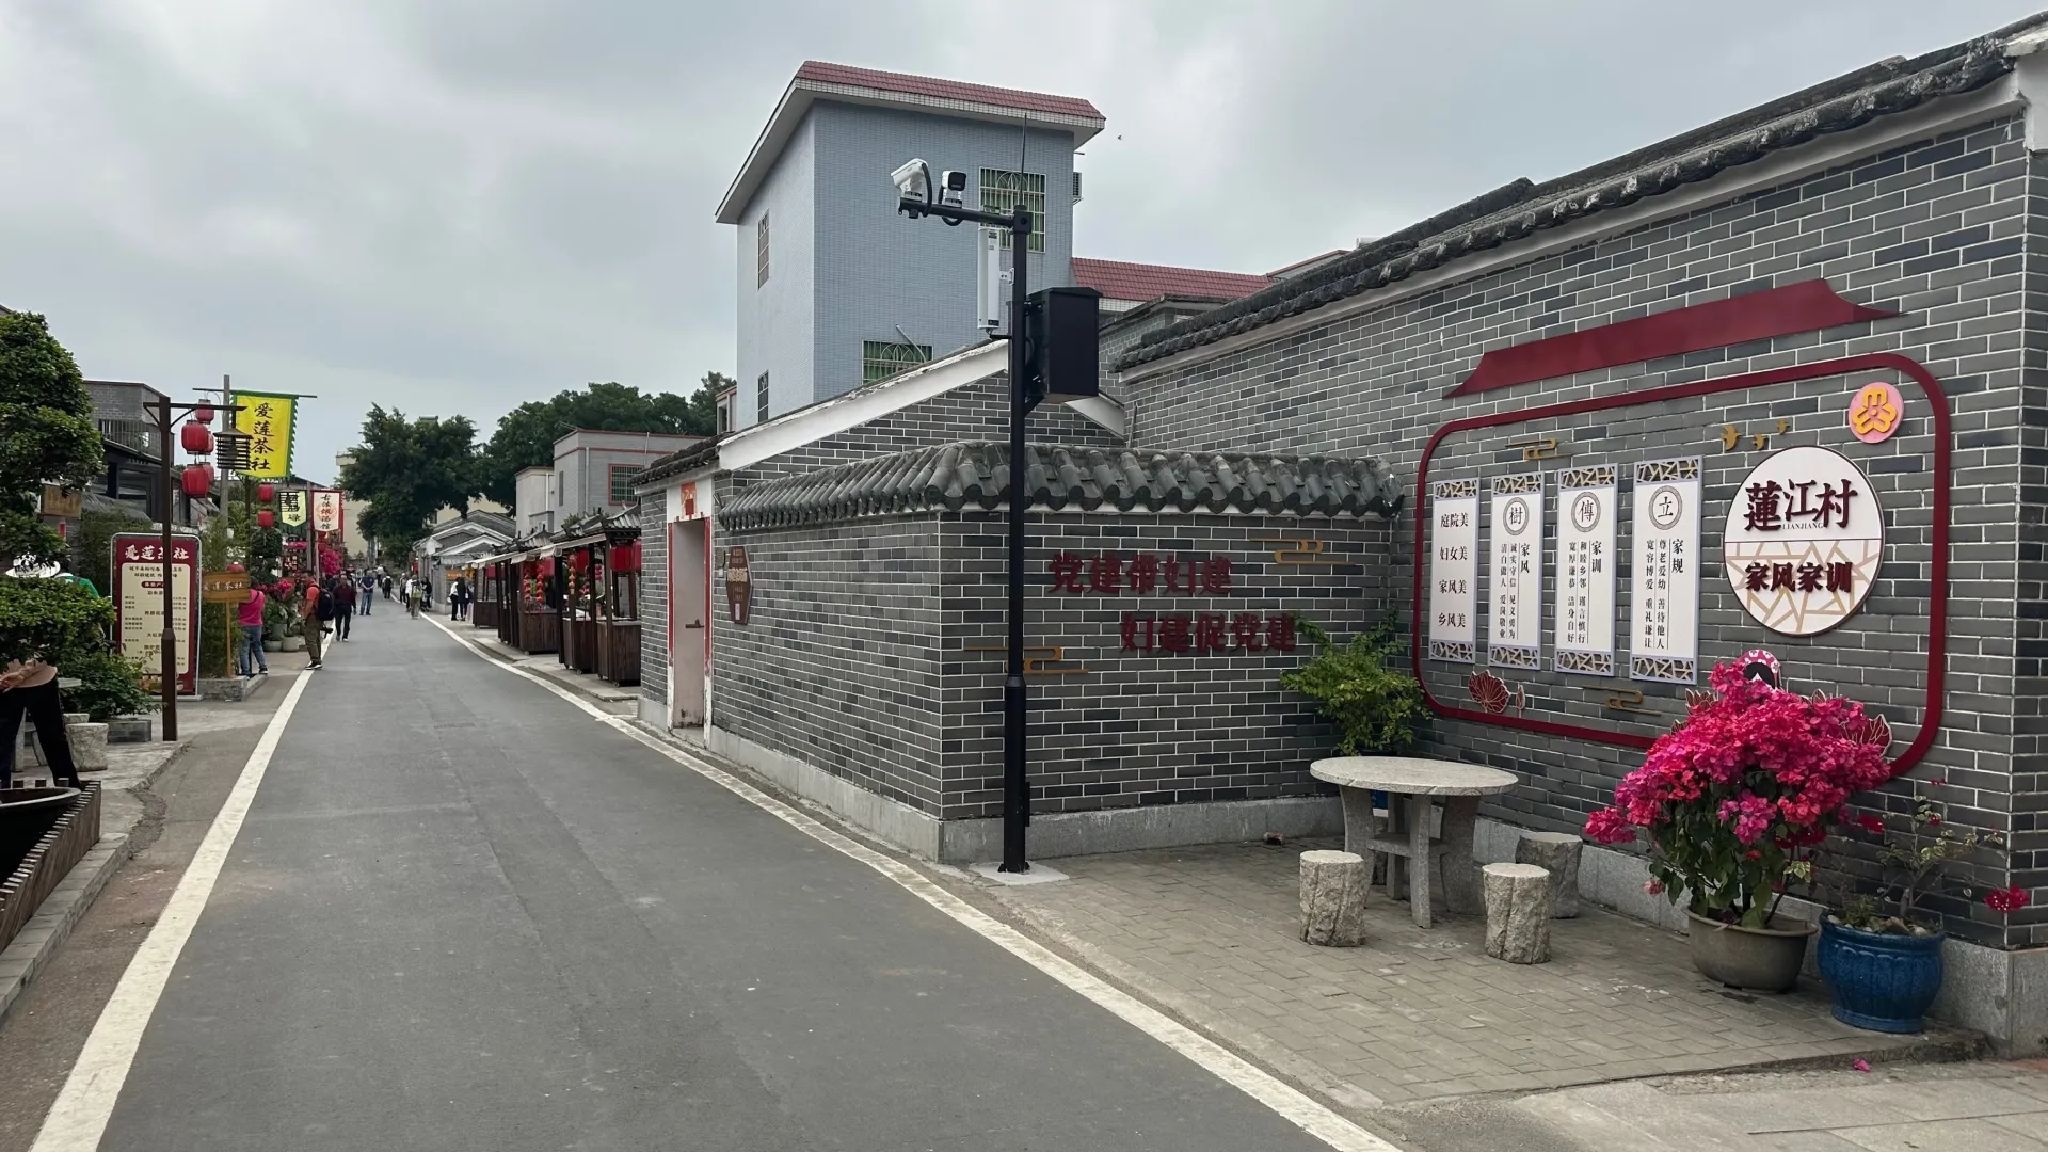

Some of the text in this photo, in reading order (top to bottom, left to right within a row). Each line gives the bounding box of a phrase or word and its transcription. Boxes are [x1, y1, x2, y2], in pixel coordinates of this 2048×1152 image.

[1440, 512, 1469, 528] 庭院美
[1509, 507, 1523, 525] 樹
[1579, 500, 1595, 522] 傳
[1658, 496, 1674, 518] 立
[1743, 479, 1858, 532] 蓮江村
[1439, 546, 1468, 562] 妇女美
[1520, 543, 1530, 574] 家风
[1591, 540, 1602, 573] 家训
[1671, 539, 1684, 574] 家规
[1049, 552, 1233, 596] 党建带妇建
[1439, 579, 1467, 595] 家风美
[1744, 561, 1854, 593] 家风家训
[1645, 540, 1654, 648] 宽容博爱 重礼谦让
[1657, 539, 1667, 650] 尊老爱幼 善待他人
[1121, 612, 1297, 654] 妇建促党建
[1438, 612, 1466, 628] 乡风美
